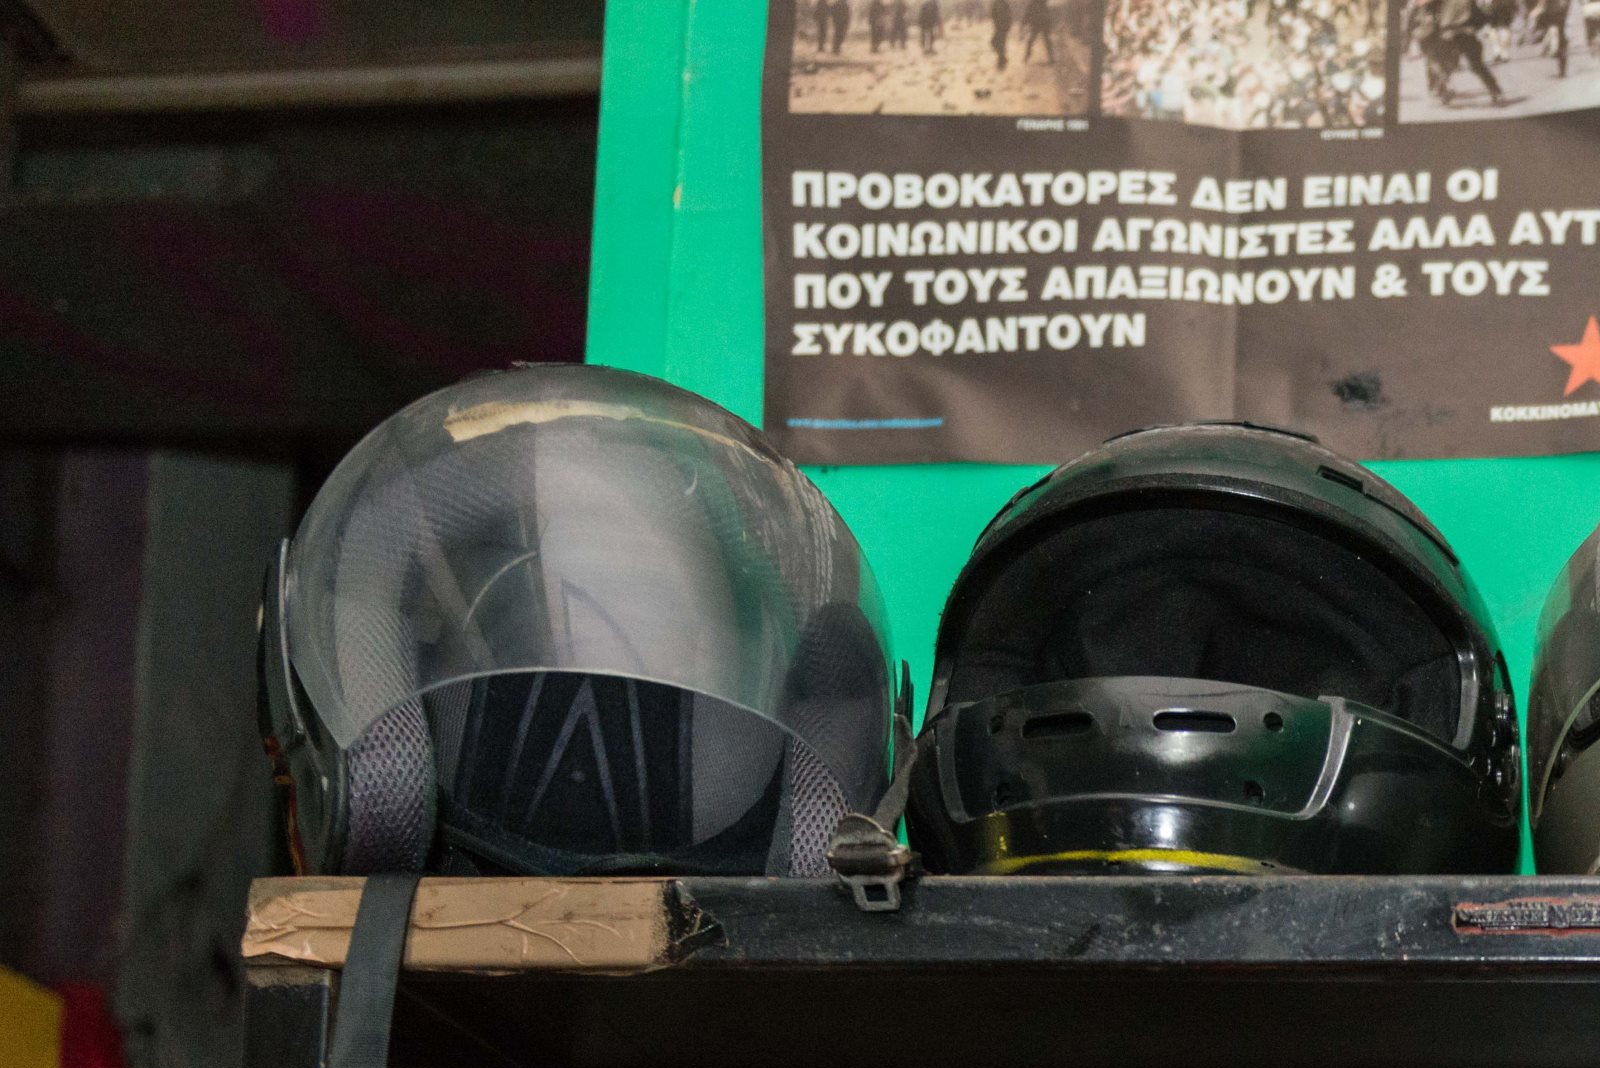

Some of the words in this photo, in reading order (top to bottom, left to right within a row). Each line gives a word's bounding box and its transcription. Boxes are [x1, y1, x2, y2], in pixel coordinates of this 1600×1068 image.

[791, 170, 1178, 210] ΠΡΟΒΟΚΑΤΟΡΕΣ
[1189, 176, 1287, 213] ΔΕΝ
[1302, 171, 1432, 208] ΕΙΝΑΙ
[1446, 168, 1499, 202] ΟΙ
[792, 218, 1078, 259] ΚΟΙΝΩΝΙΚΟΙ
[1091, 217, 1356, 260] ΑΓΩΝΙΣΤΕΣ
[1367, 213, 1496, 251] ΑΛΛΑ
[793, 271, 893, 309] ΠΟΥ
[904, 266, 1029, 306] ΤΟΥΣ
[1040, 264, 1356, 305] ΑΠΑΞΙΩΝΟΥΝ
[1370, 263, 1408, 299] &
[1421, 260, 1551, 297] ΤΟΥΣ
[790, 312, 1147, 358] ΣΥΚΟΦΑΝΤΟΥΝ
